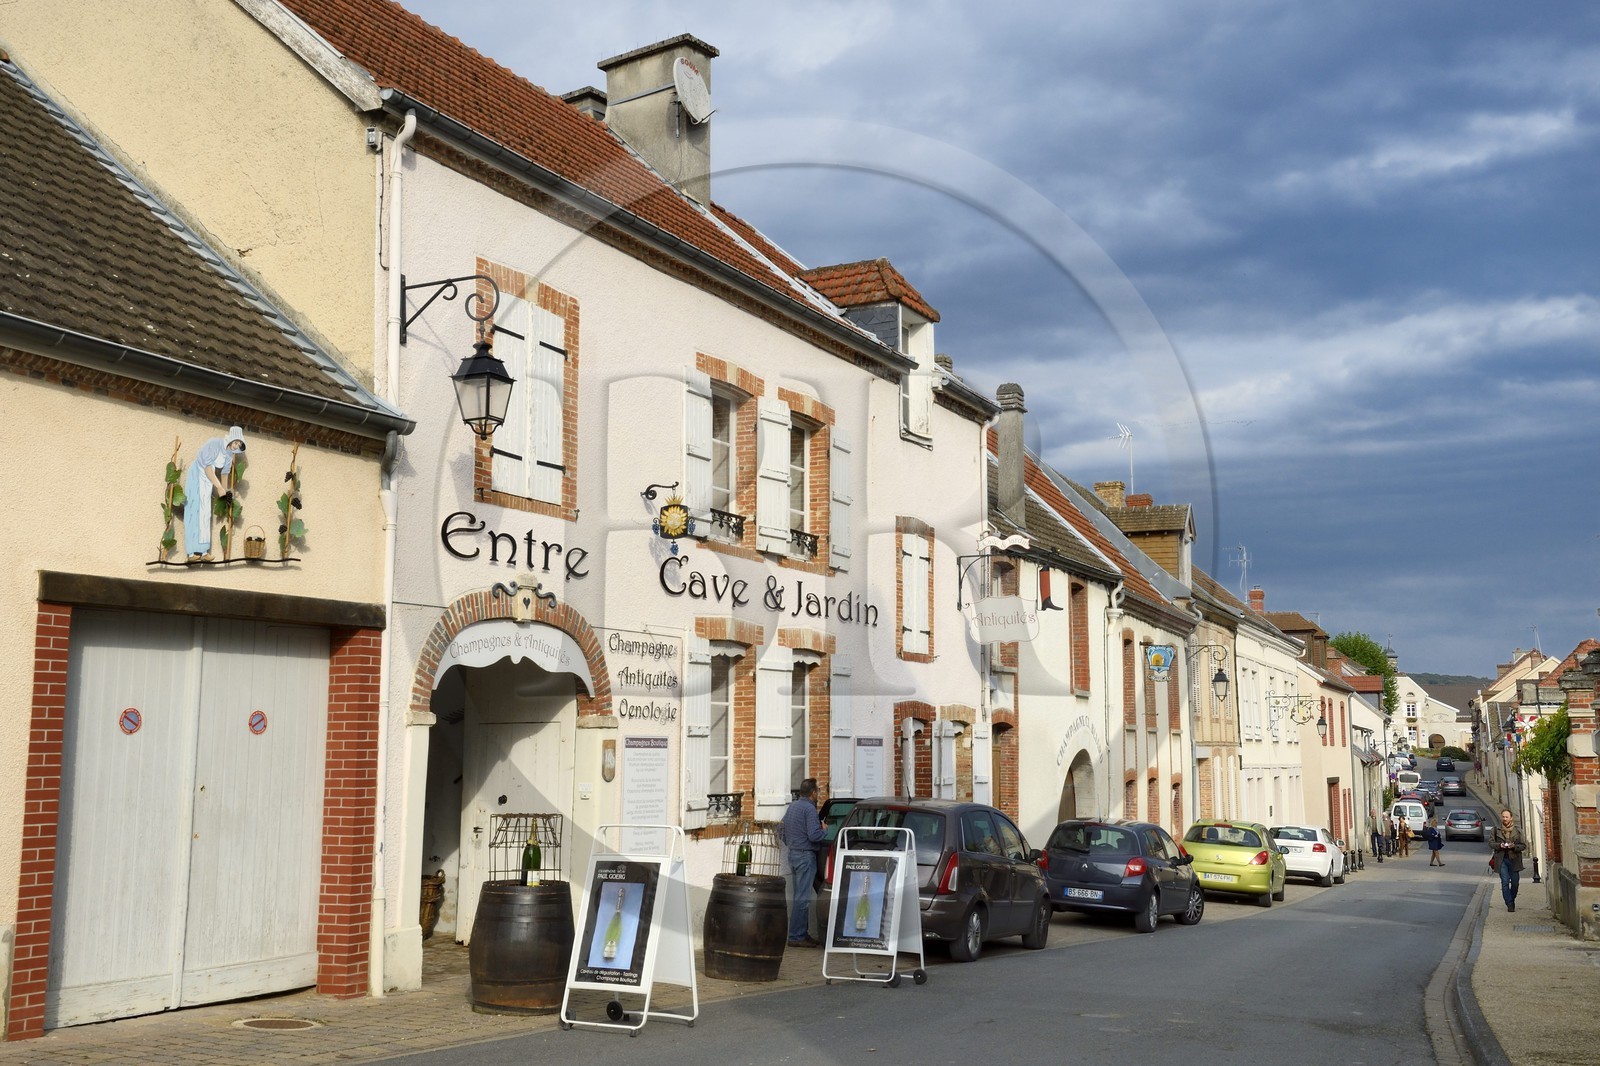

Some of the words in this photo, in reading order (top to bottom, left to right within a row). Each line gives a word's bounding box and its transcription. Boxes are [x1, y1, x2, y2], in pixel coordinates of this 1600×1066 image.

[441, 511, 590, 581] Entre
[659, 554, 749, 608] Cave
[763, 575, 785, 612] &
[791, 580, 879, 627] Jardin
[974, 610, 1036, 629] Antiquités
[449, 634, 512, 659] Champagnes
[514, 631, 522, 647] &
[524, 633, 571, 666] Antiquités
[619, 698, 677, 724] Oenologie
